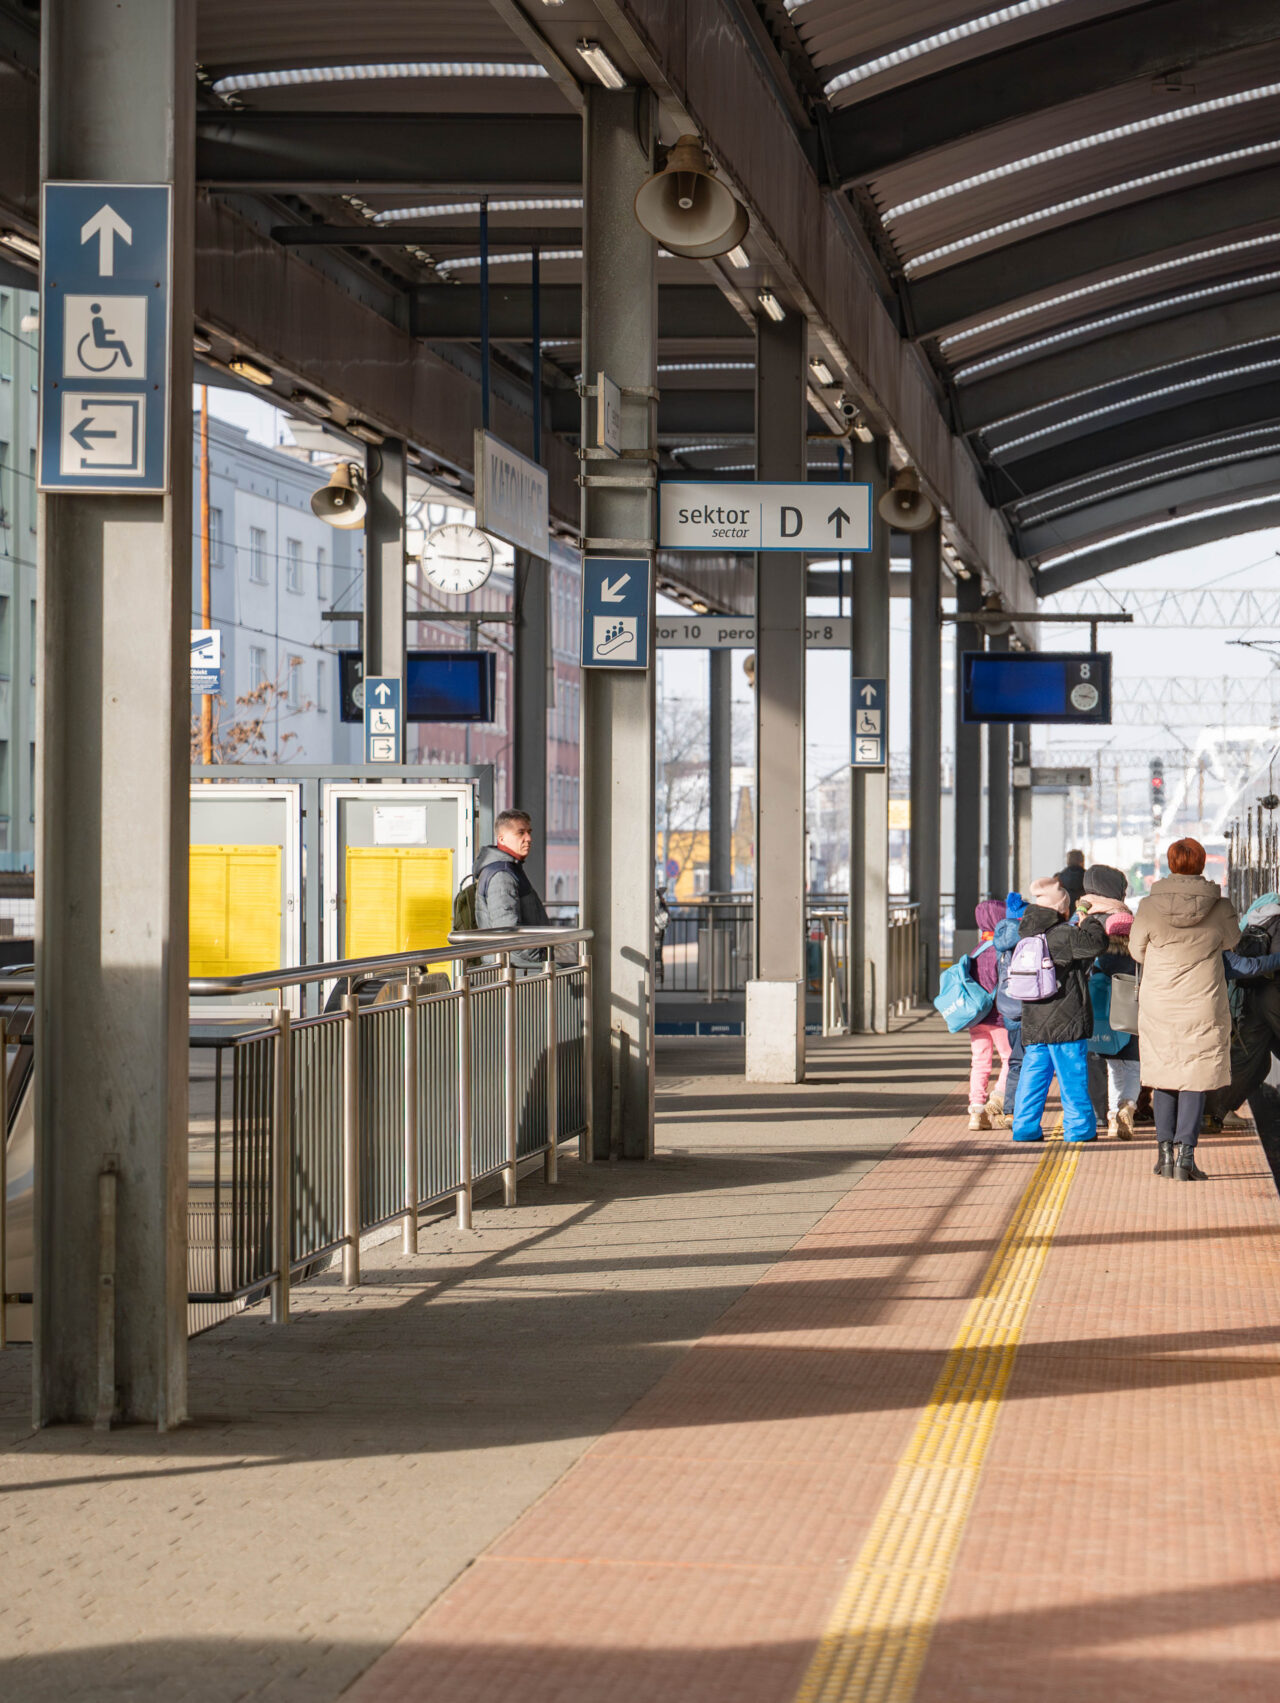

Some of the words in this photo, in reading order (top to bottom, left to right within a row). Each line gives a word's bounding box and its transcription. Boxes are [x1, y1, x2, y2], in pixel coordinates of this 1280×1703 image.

[678, 504, 750, 525] sektor
[779, 506, 804, 538] D
[711, 526, 750, 538] sector
[683, 625, 702, 640] 10
[718, 629, 755, 642] pero
[805, 630, 821, 640] or
[824, 626, 833, 640] 8
[1080, 663, 1090, 679] 8
